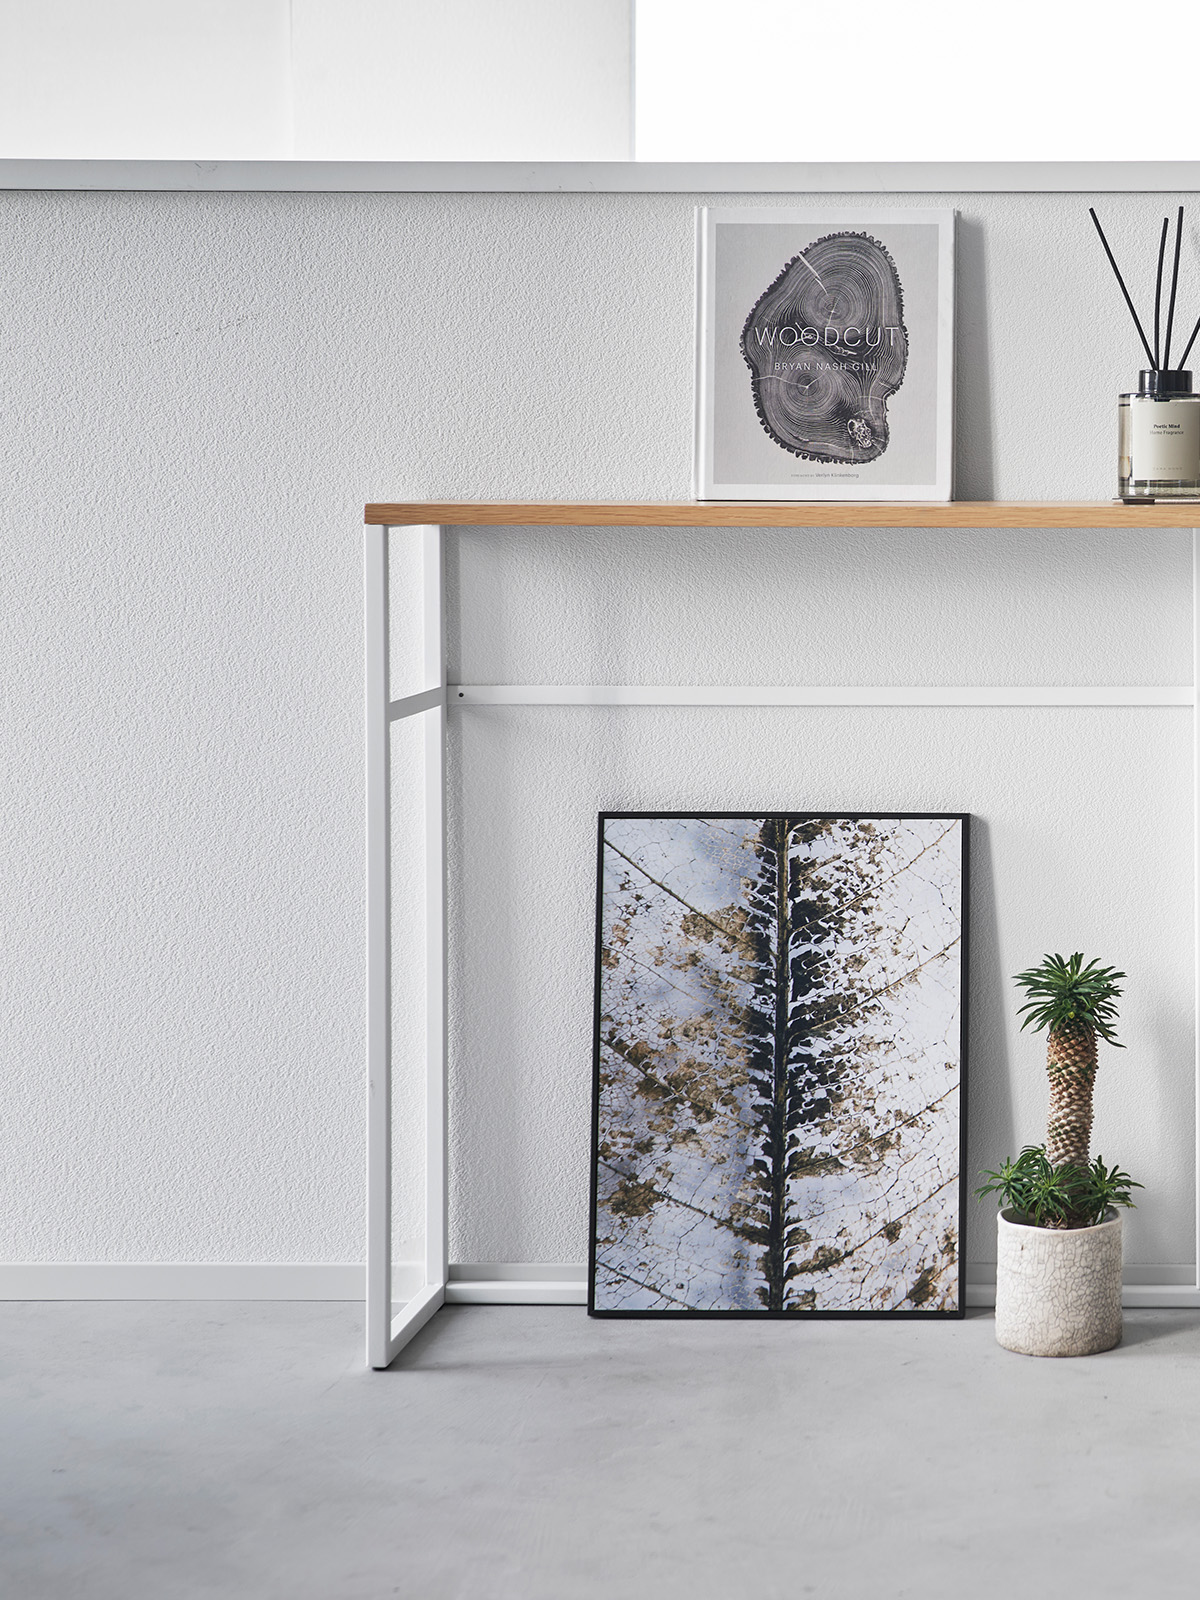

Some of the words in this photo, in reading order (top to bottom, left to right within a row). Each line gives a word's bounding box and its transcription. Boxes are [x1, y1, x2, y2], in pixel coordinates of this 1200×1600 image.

[754, 326, 900, 347] WOODCUT
[774, 362, 811, 371] BRYAN
[816, 362, 847, 371] NASH
[852, 362, 878, 371] GILL
